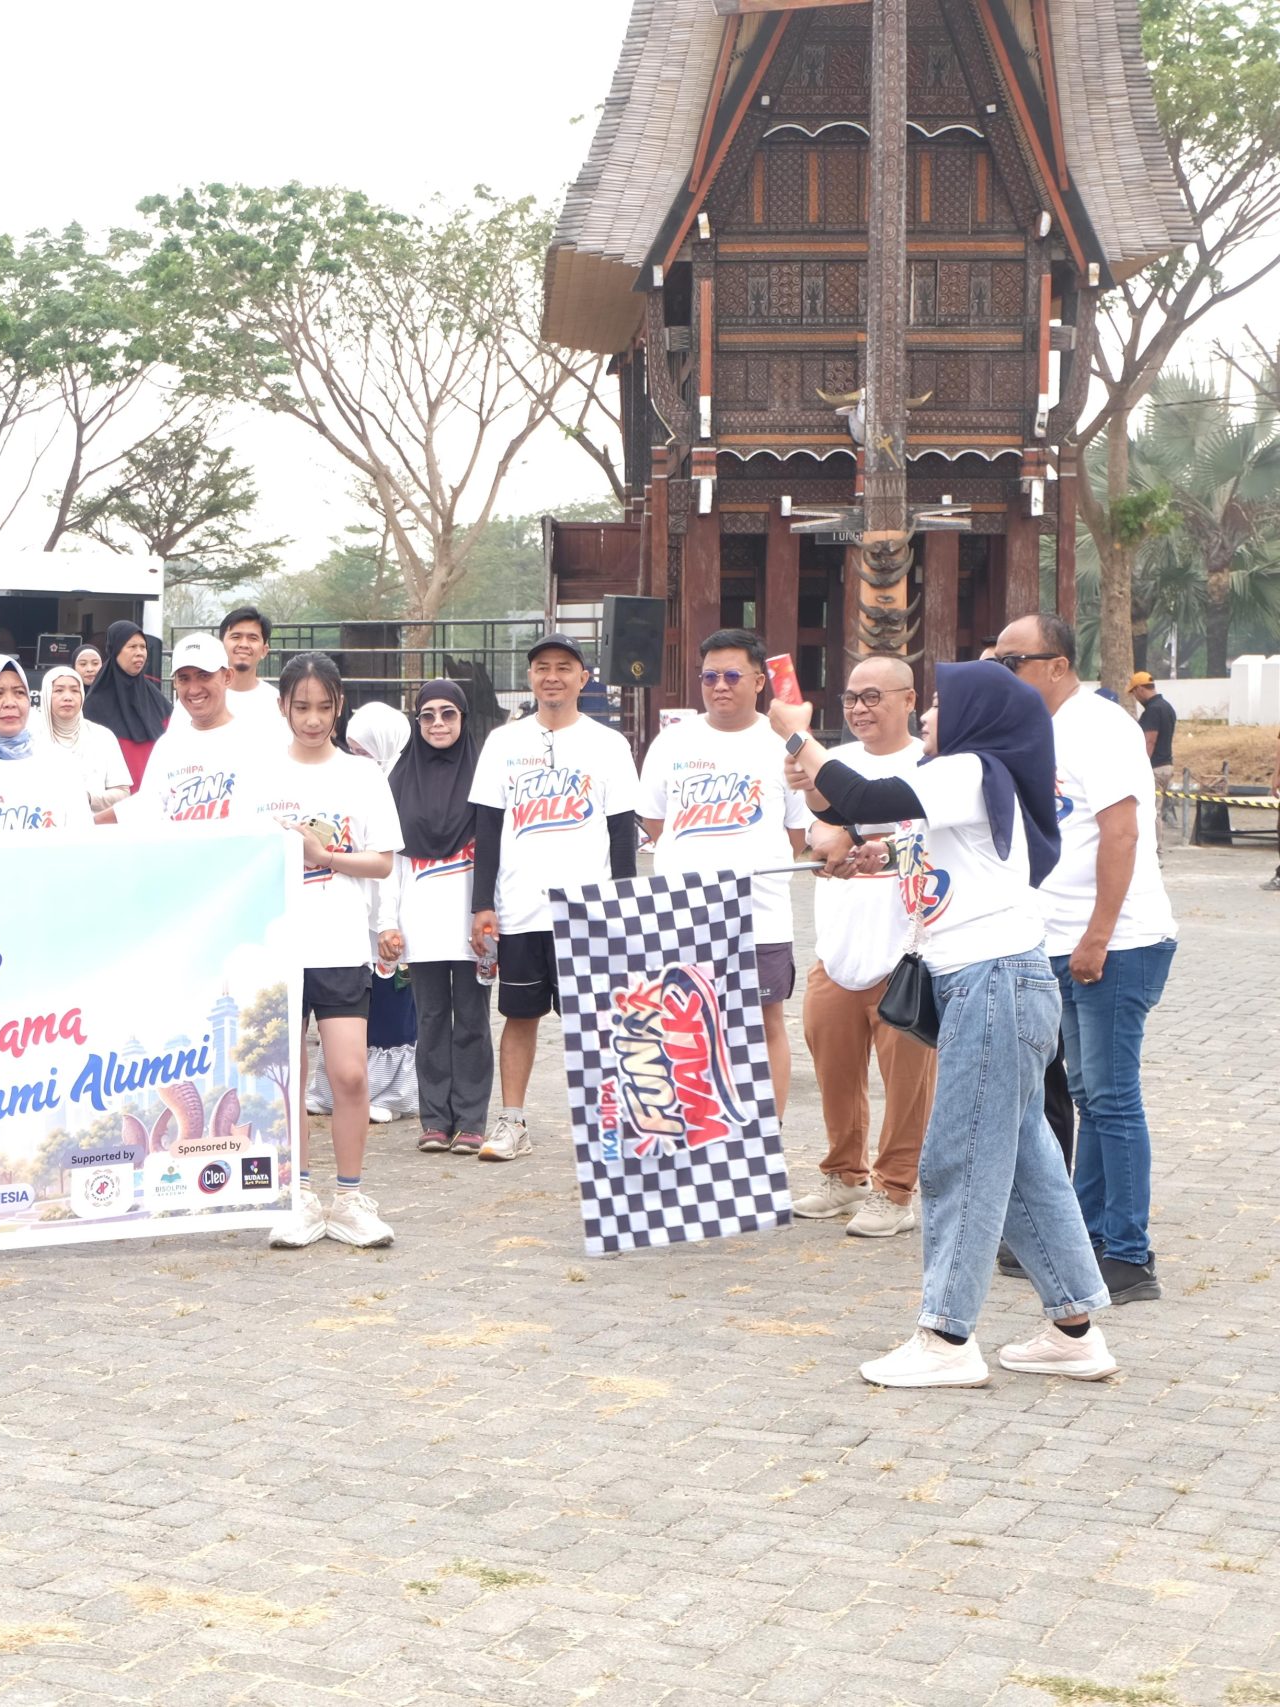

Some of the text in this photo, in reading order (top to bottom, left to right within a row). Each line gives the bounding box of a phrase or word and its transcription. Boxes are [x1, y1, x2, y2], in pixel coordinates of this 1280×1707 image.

[173, 772, 224, 814] FUN
[514, 767, 569, 806] FUN
[681, 772, 739, 809] FUN
[511, 795, 585, 832] WALK
[672, 800, 754, 832] WALK
[70, 1034, 212, 1111] Alumni
[613, 1034, 686, 1137] FUN
[659, 989, 730, 1148] WALK
[71, 1149, 135, 1165] Supported by
[178, 1141, 242, 1154] Sponsored by
[204, 1170, 226, 1184] Cleo
